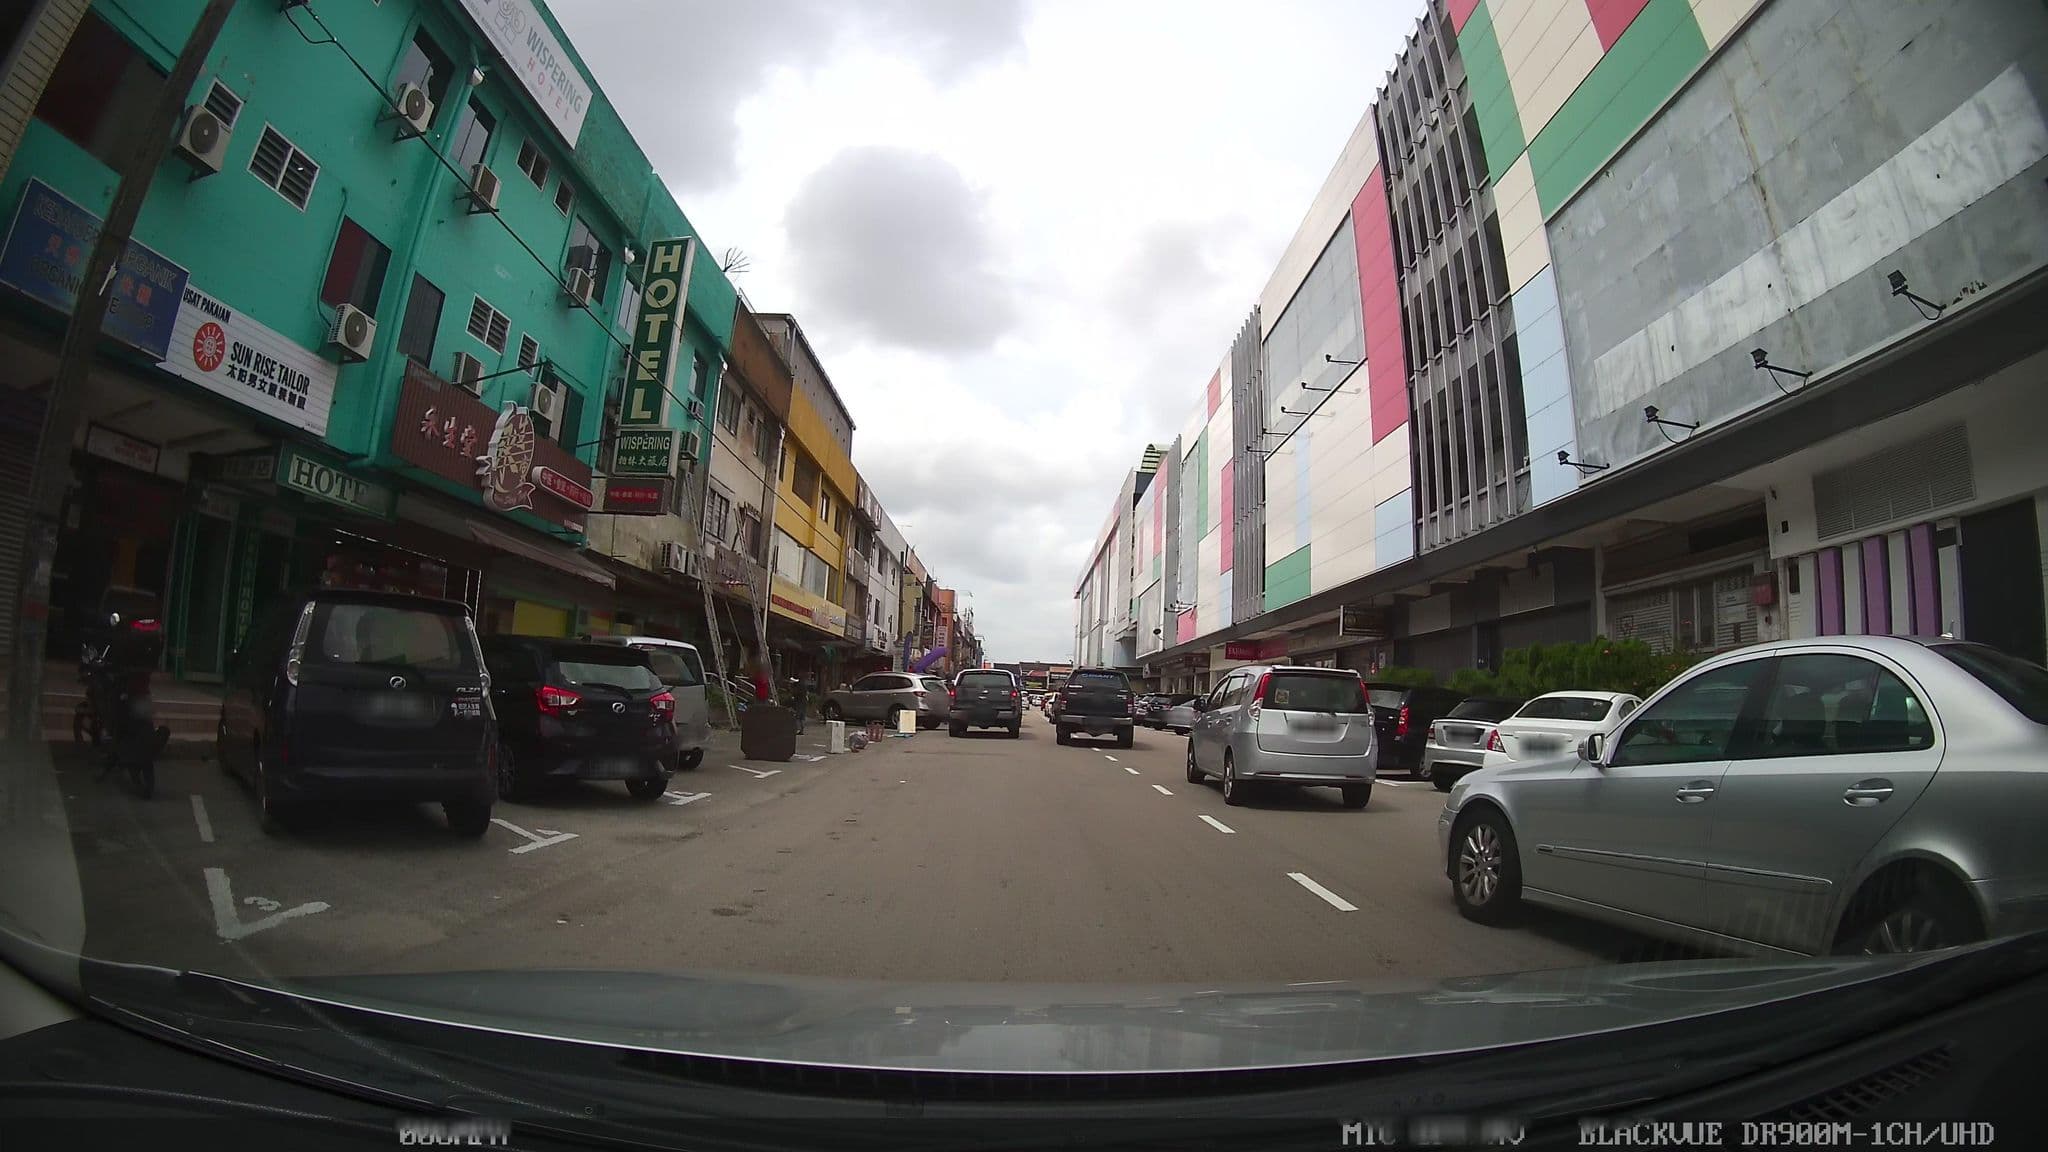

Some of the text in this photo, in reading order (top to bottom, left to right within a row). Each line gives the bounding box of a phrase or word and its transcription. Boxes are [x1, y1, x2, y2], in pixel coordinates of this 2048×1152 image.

[526, 26, 584, 114] WISPERING
[526, 57, 569, 121] HOTEL
[200, 296, 232, 324] PAKAIAN
[630, 244, 682, 420] HOTEL
[231, 341, 311, 396] SUN RISE TAILOR
[619, 435, 671, 450] WISPERING
[292, 457, 374, 505] HOTE
